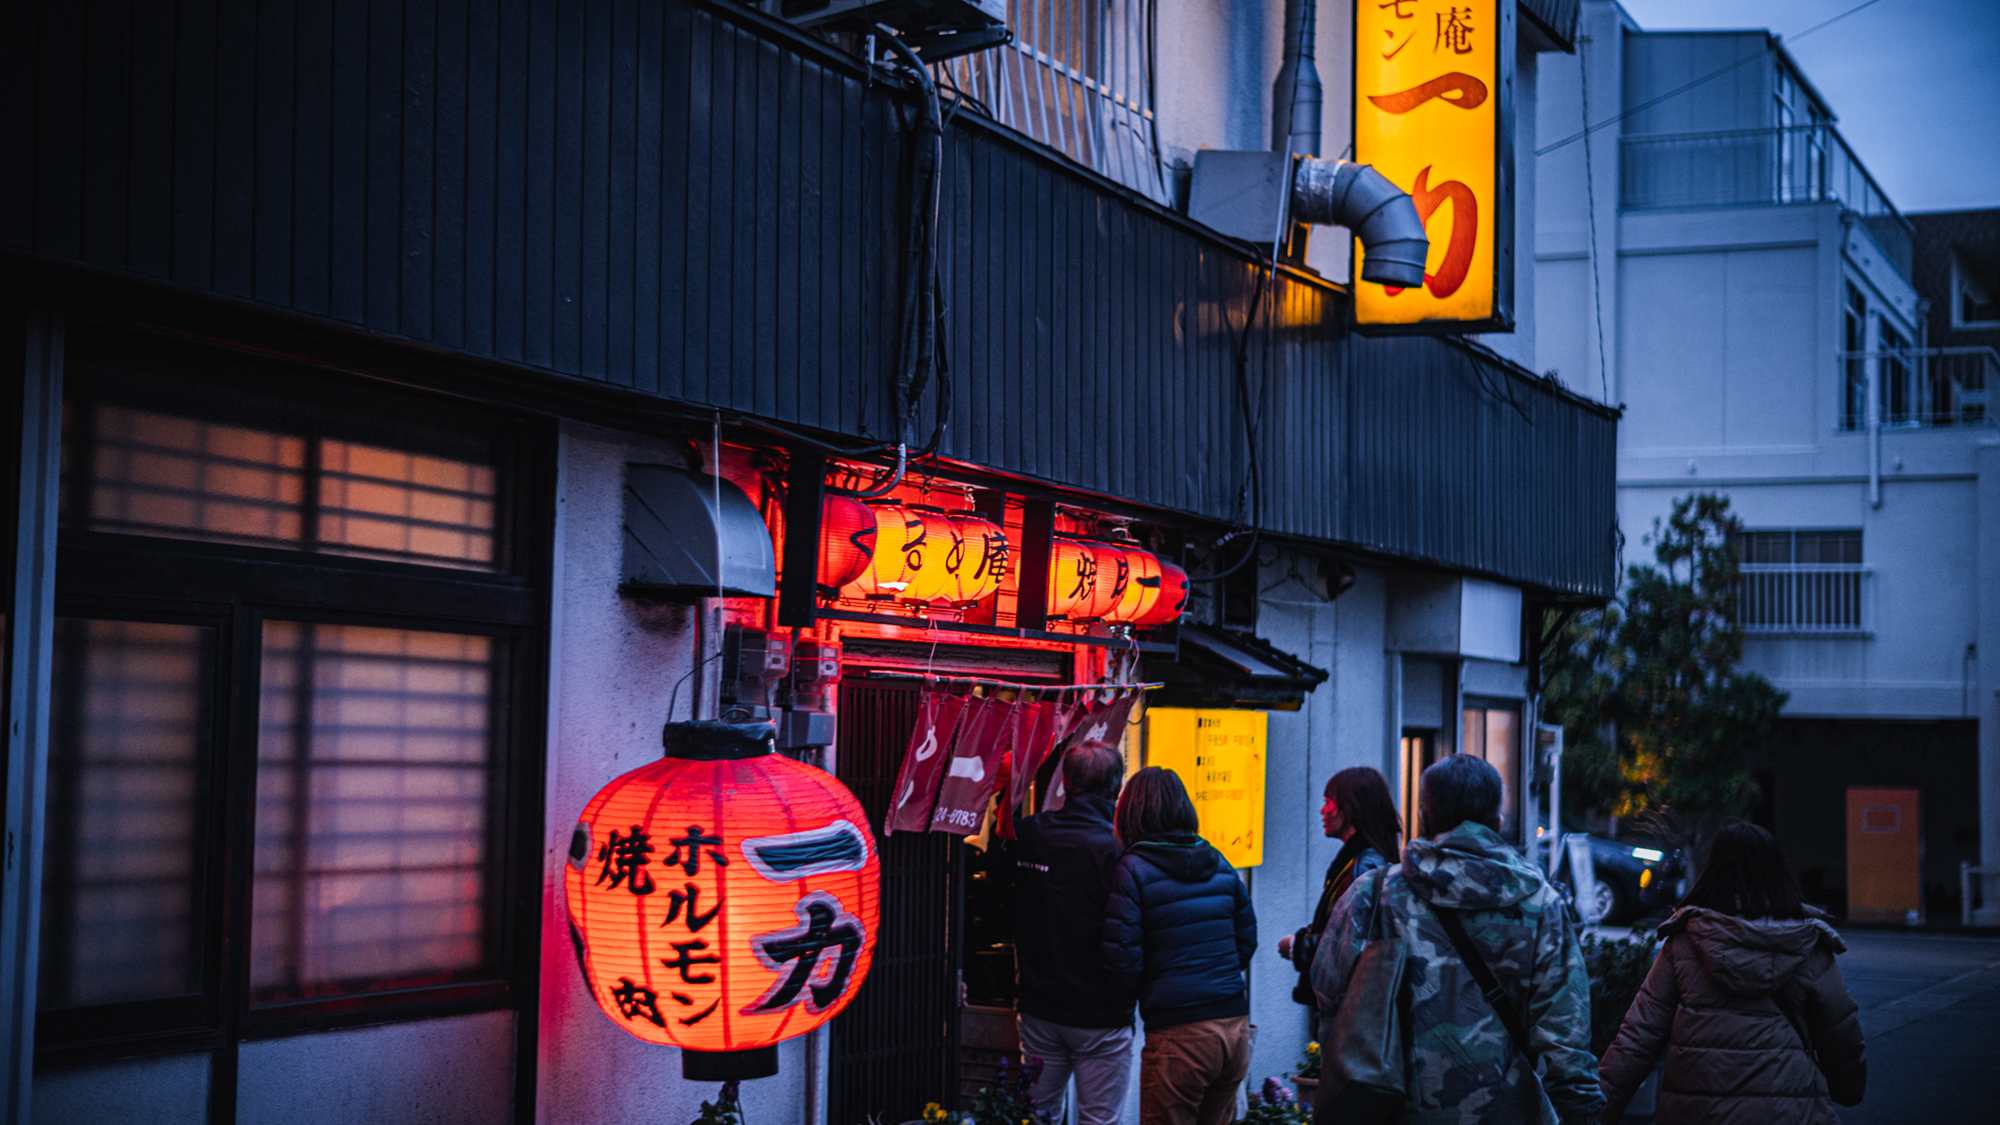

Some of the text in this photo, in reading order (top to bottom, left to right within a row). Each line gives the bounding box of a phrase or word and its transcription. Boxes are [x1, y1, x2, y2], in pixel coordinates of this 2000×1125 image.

[1433, 7, 1475, 55] 庵
[660, 824, 730, 1026] ホルモン
[740, 819, 868, 1015] 一力
